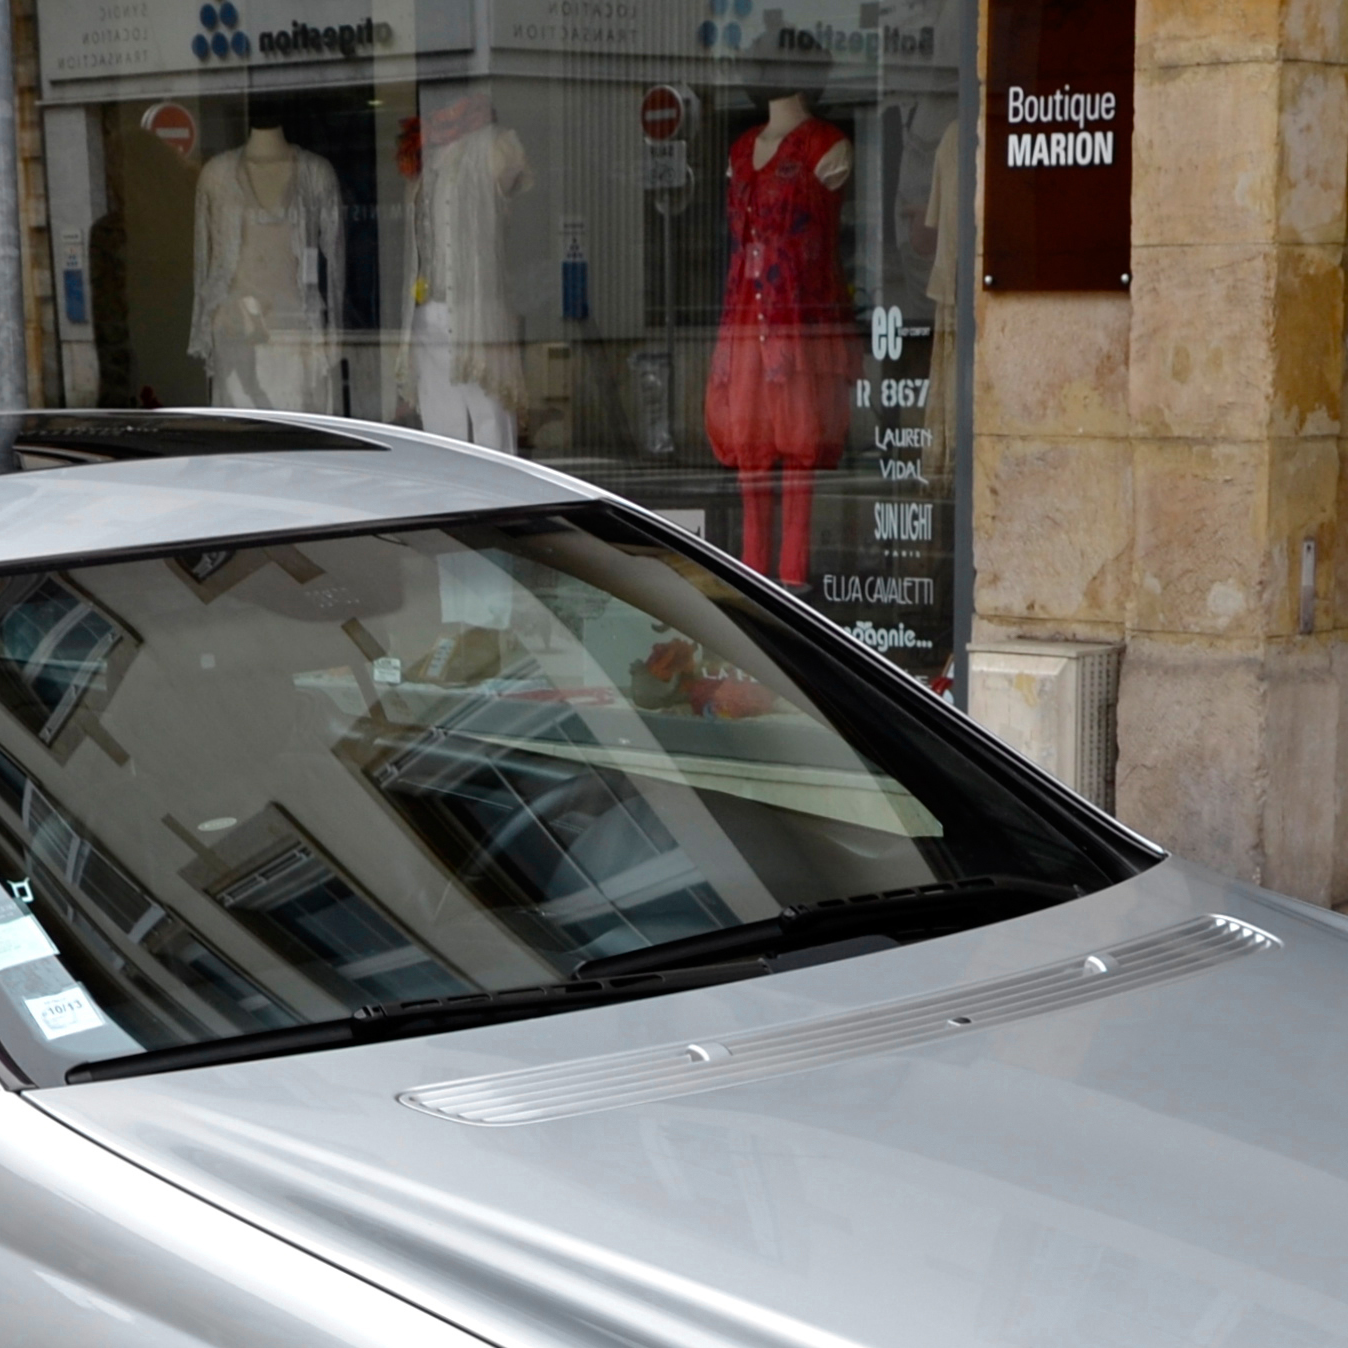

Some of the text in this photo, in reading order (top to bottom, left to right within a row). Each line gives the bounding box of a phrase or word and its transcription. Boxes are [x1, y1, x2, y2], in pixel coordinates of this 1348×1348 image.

[1008, 84, 1116, 129] Boutique
[1007, 131, 1114, 167] MARION
[871, 305, 903, 361] ec
[856, 378, 931, 408] R 867
[874, 425, 933, 450] LAUREN
[879, 458, 929, 484] VIDAL
[884, 550, 921, 558] PARIS
[823, 574, 934, 605] ELISA CAVALETTI
[47, 999, 83, 1017] 10/13
